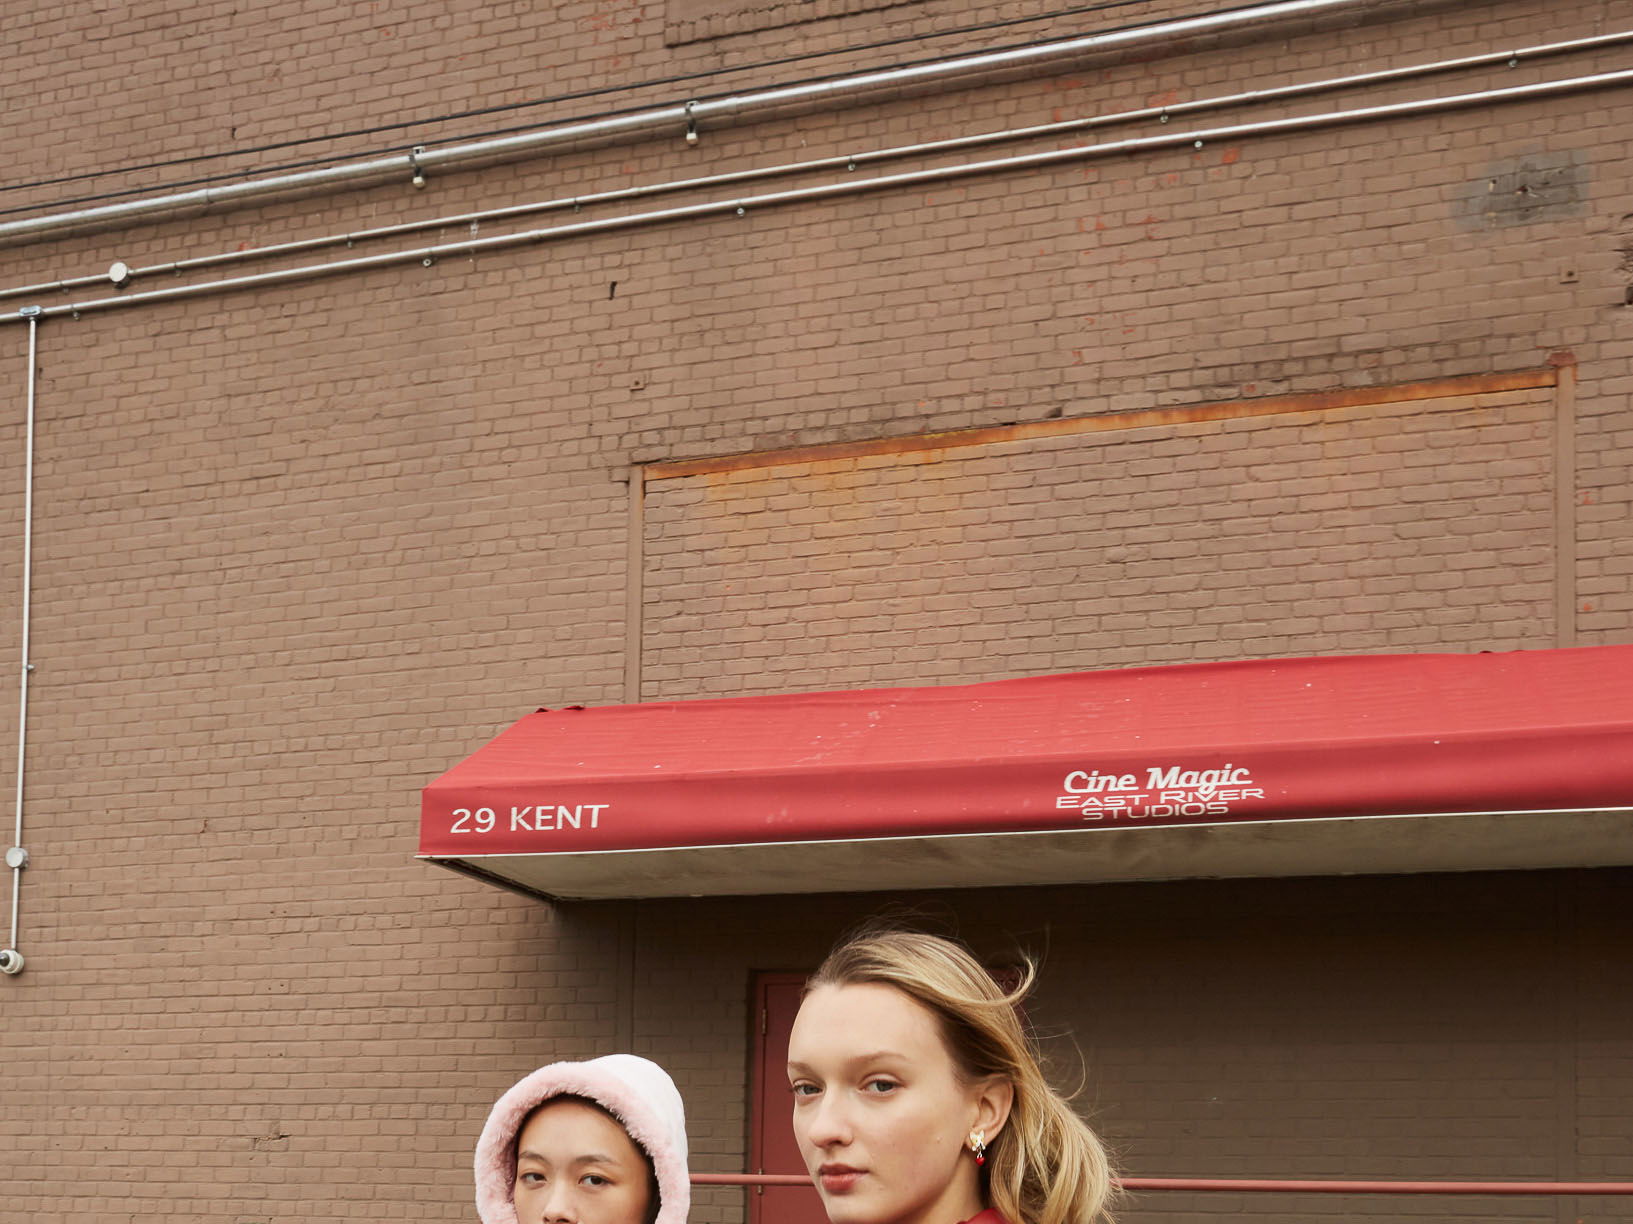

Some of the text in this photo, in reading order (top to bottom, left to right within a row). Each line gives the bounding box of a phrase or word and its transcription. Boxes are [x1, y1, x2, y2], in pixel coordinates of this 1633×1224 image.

[1064, 763, 1253, 794] Cine Magic
[1055, 788, 1265, 809] EAST RIVER
[1082, 801, 1229, 821] STUDIOS
[450, 804, 610, 834] 29 KENT
